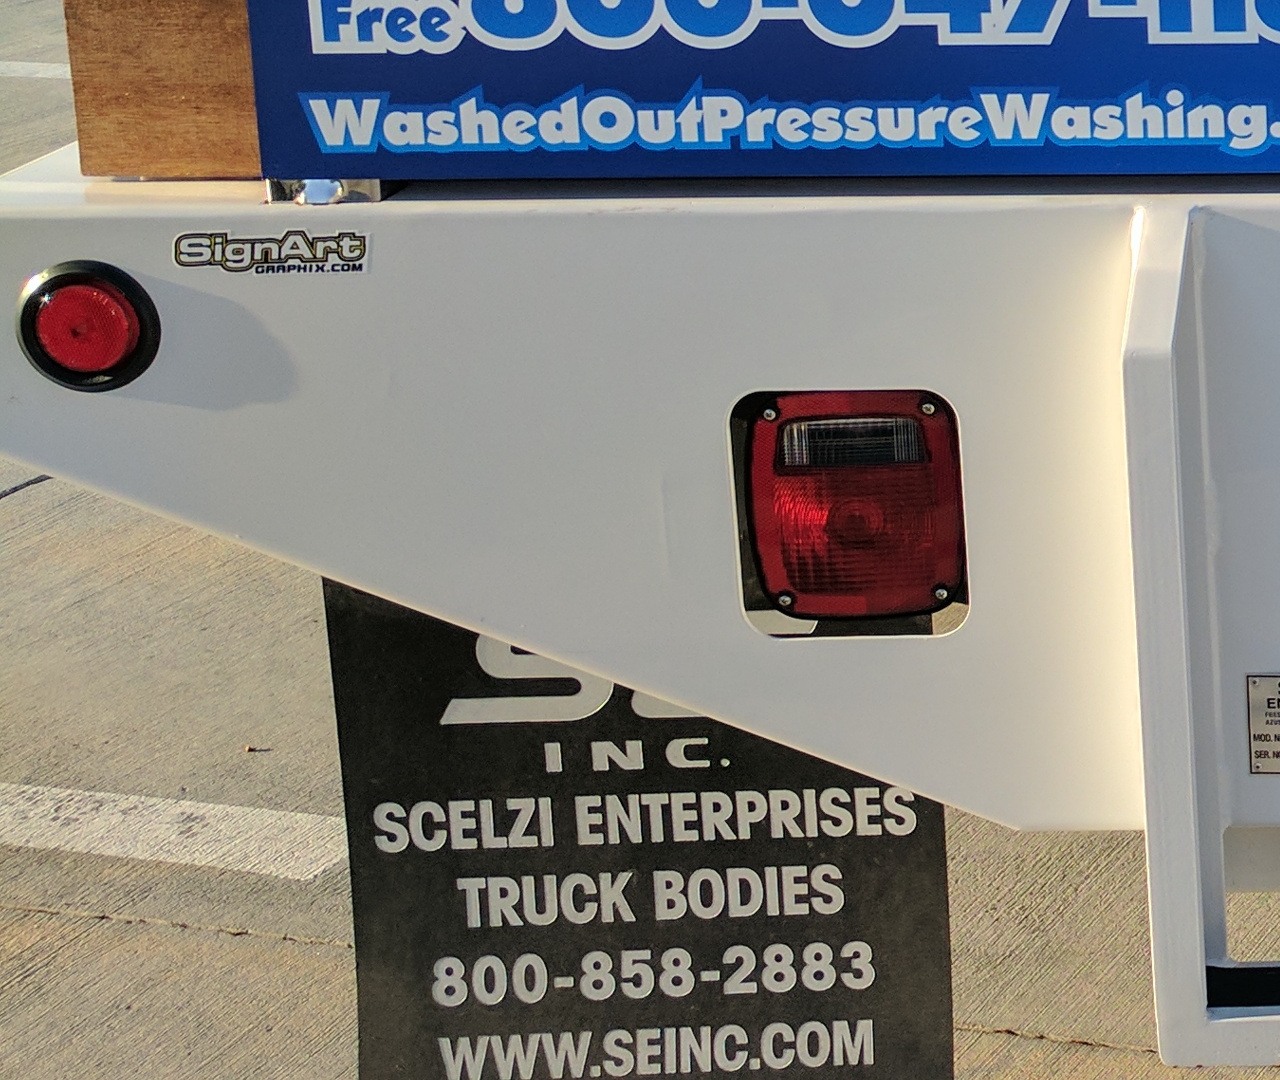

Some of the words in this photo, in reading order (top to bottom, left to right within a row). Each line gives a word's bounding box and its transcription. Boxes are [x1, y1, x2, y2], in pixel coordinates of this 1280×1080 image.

[175, 230, 367, 273] SignArt
[254, 262, 364, 275] GRAPHIX.COM
[544, 737, 731, 774] INC.
[372, 795, 555, 854] SCELZI
[575, 786, 918, 846] ENTERPRISES
[456, 870, 637, 930] TRUCK
[653, 863, 846, 922] BODIES
[431, 941, 877, 1009] 800-858-2883
[437, 1019, 877, 1080] WWW.SEINC.COM
